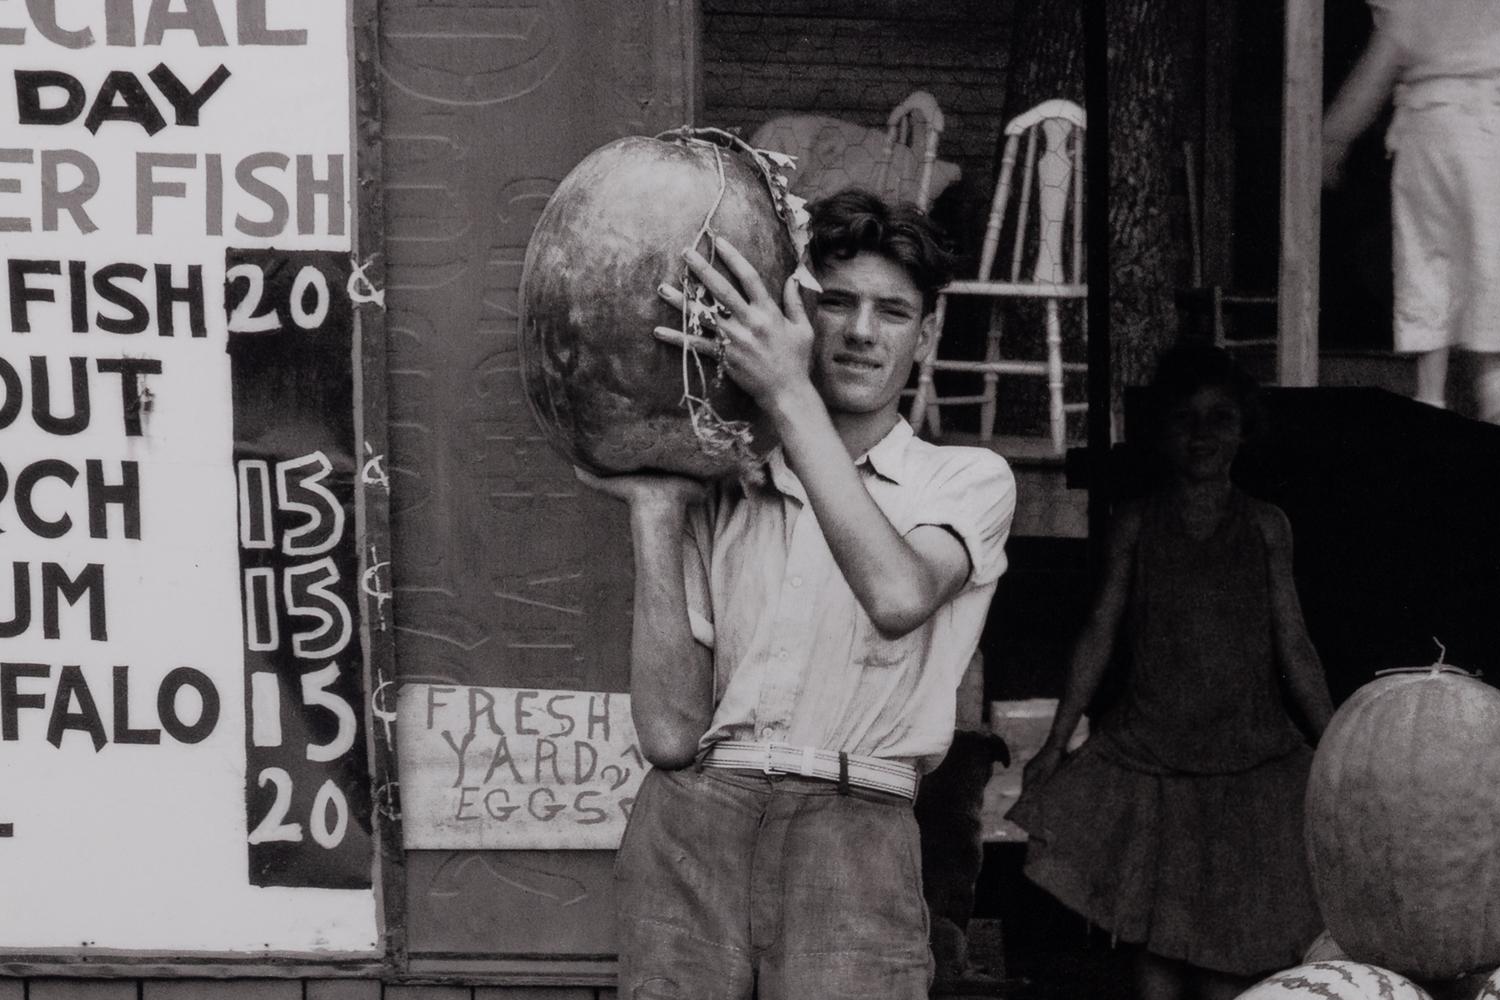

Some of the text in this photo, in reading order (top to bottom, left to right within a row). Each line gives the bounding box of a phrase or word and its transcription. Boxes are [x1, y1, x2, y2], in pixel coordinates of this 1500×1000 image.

[0, 0, 308, 49] CIAL
[14, 62, 232, 137] DAY
[135, 151, 345, 237] FISH
[8, 259, 207, 338] FISH
[0, 459, 141, 541] CH
[0, 662, 220, 753] FALO
[426, 686, 611, 742] FRESH
[441, 730, 599, 788] YARD
[455, 787, 608, 825] EGGS
